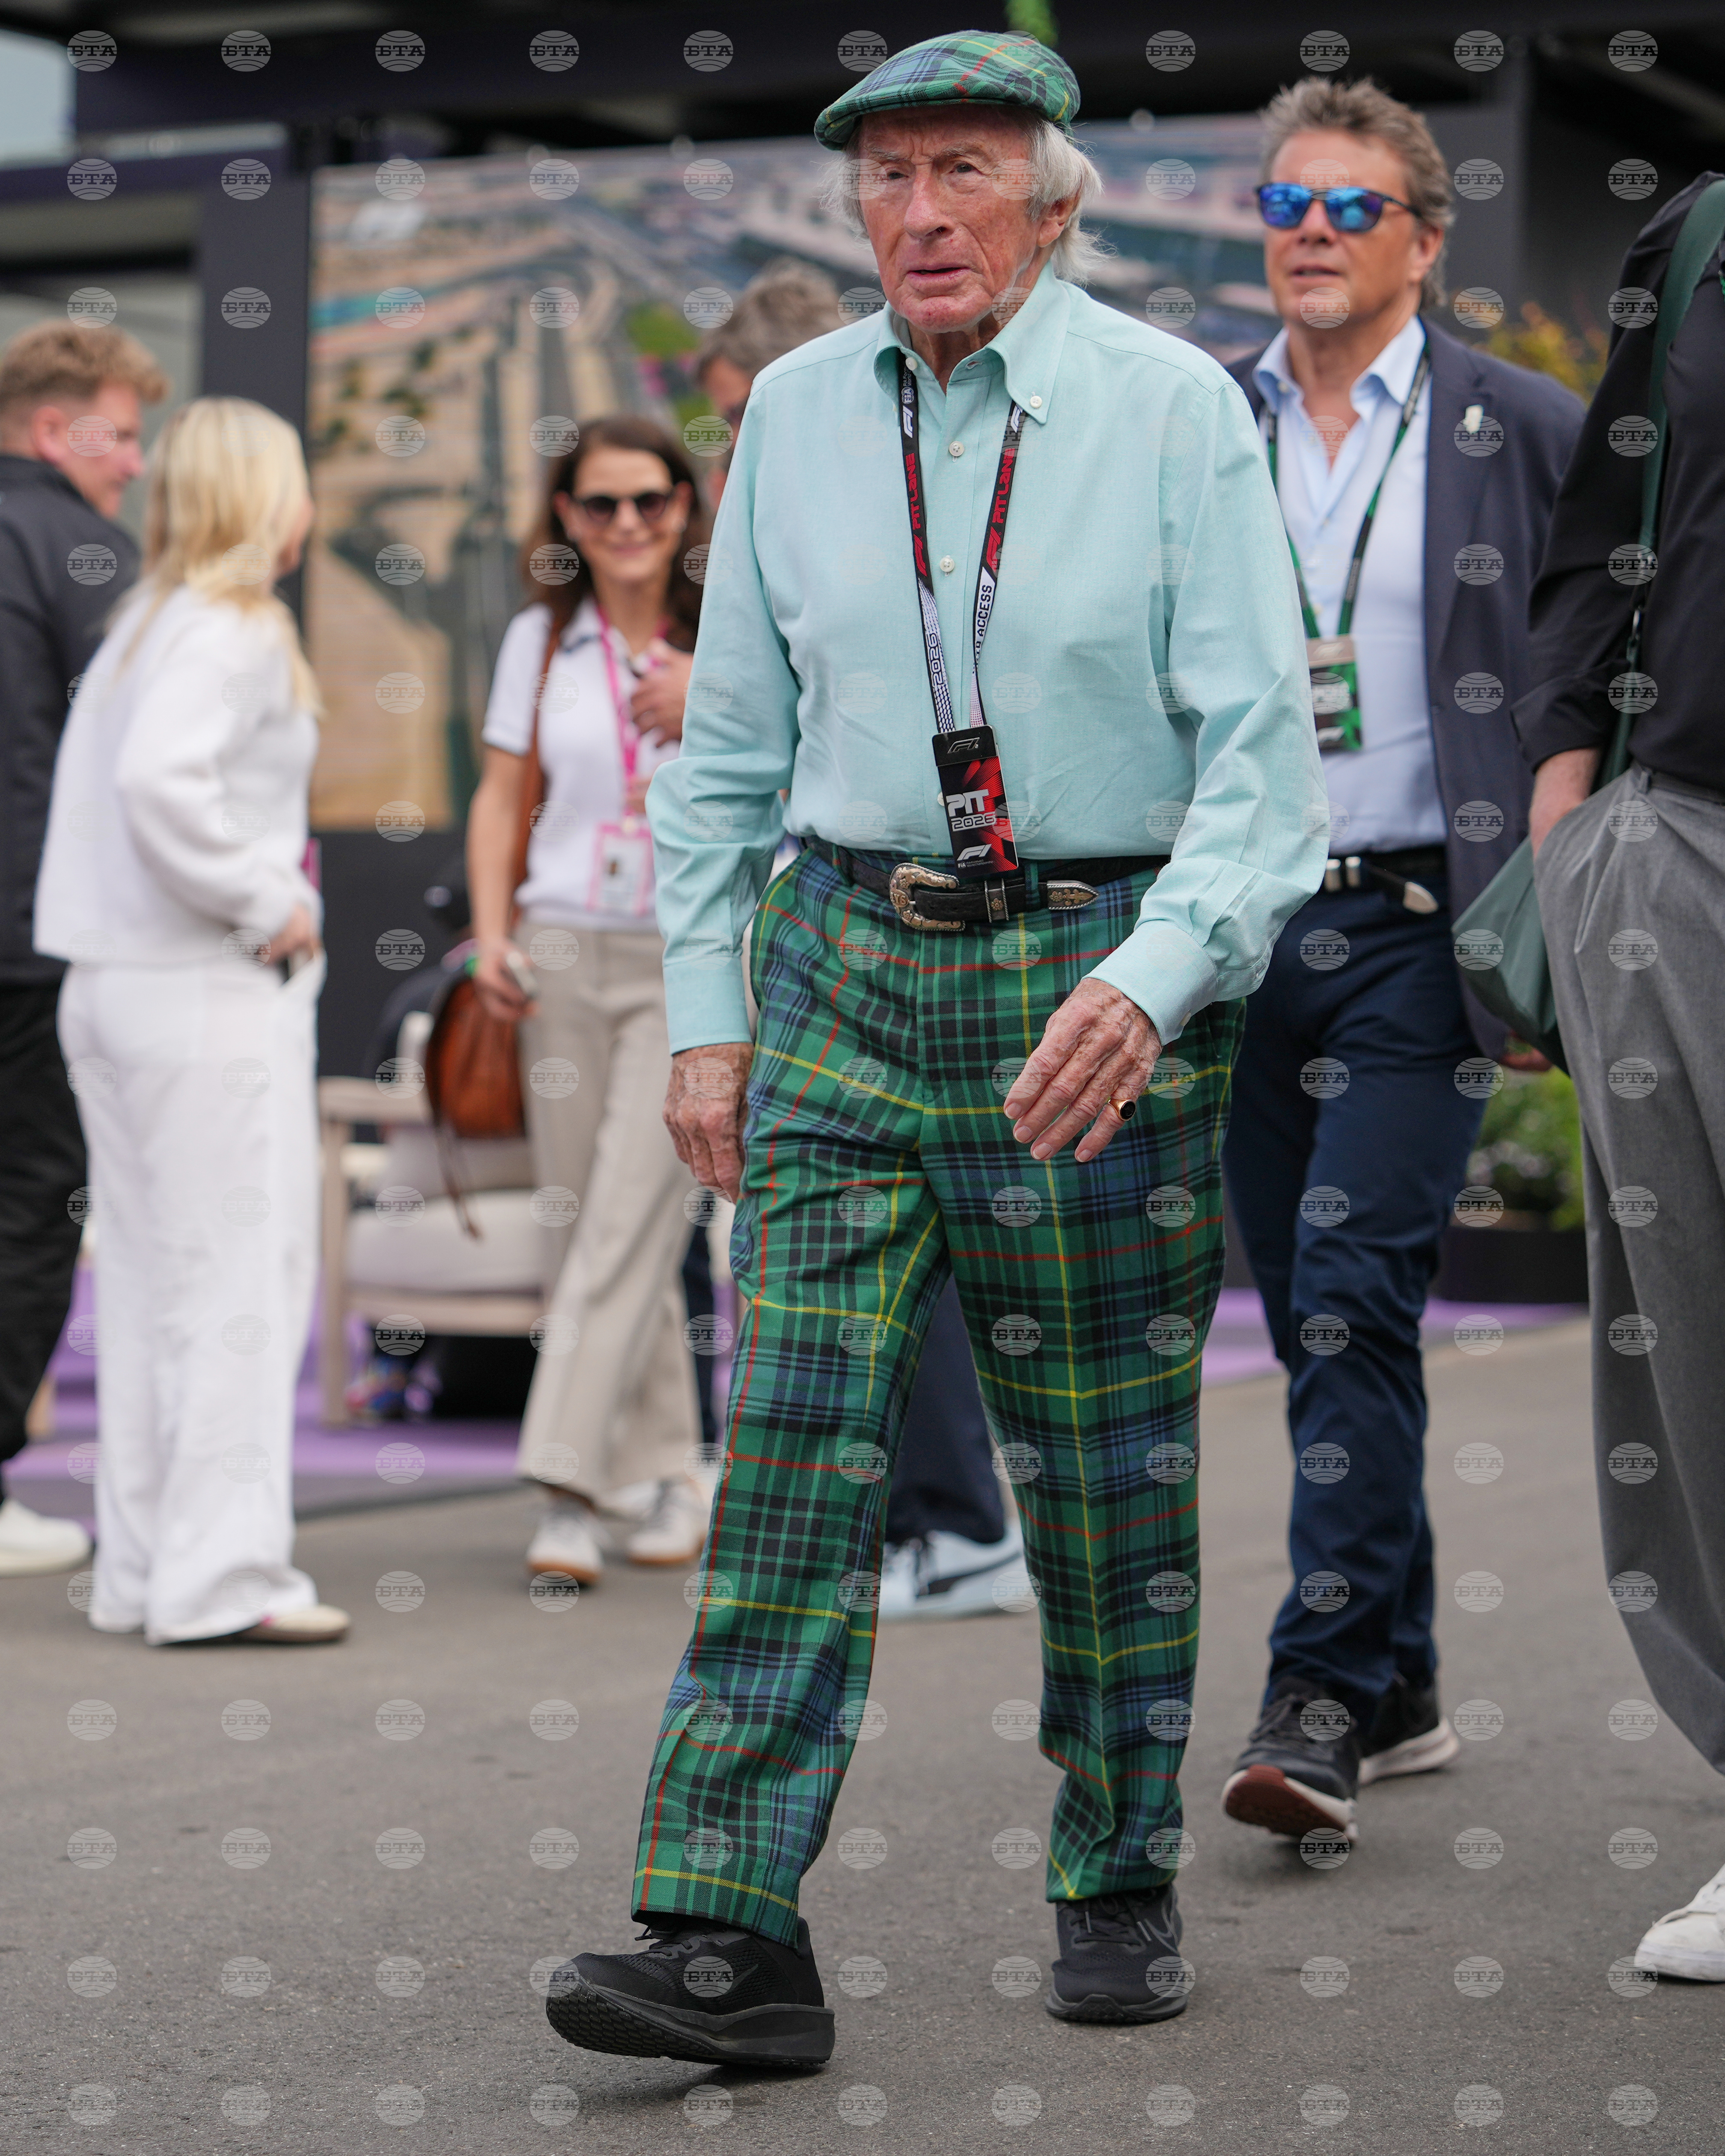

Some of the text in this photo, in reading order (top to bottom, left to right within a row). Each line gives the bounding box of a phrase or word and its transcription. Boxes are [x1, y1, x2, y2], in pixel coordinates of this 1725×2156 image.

[910, 503, 921, 530] PIT
[992, 496, 1007, 523] PIT
[977, 585, 992, 637] ACCESS
[926, 633, 944, 686] 2026
[946, 789, 990, 817] PIT
[951, 811, 998, 832] 2026
[956, 843, 993, 861] F1
